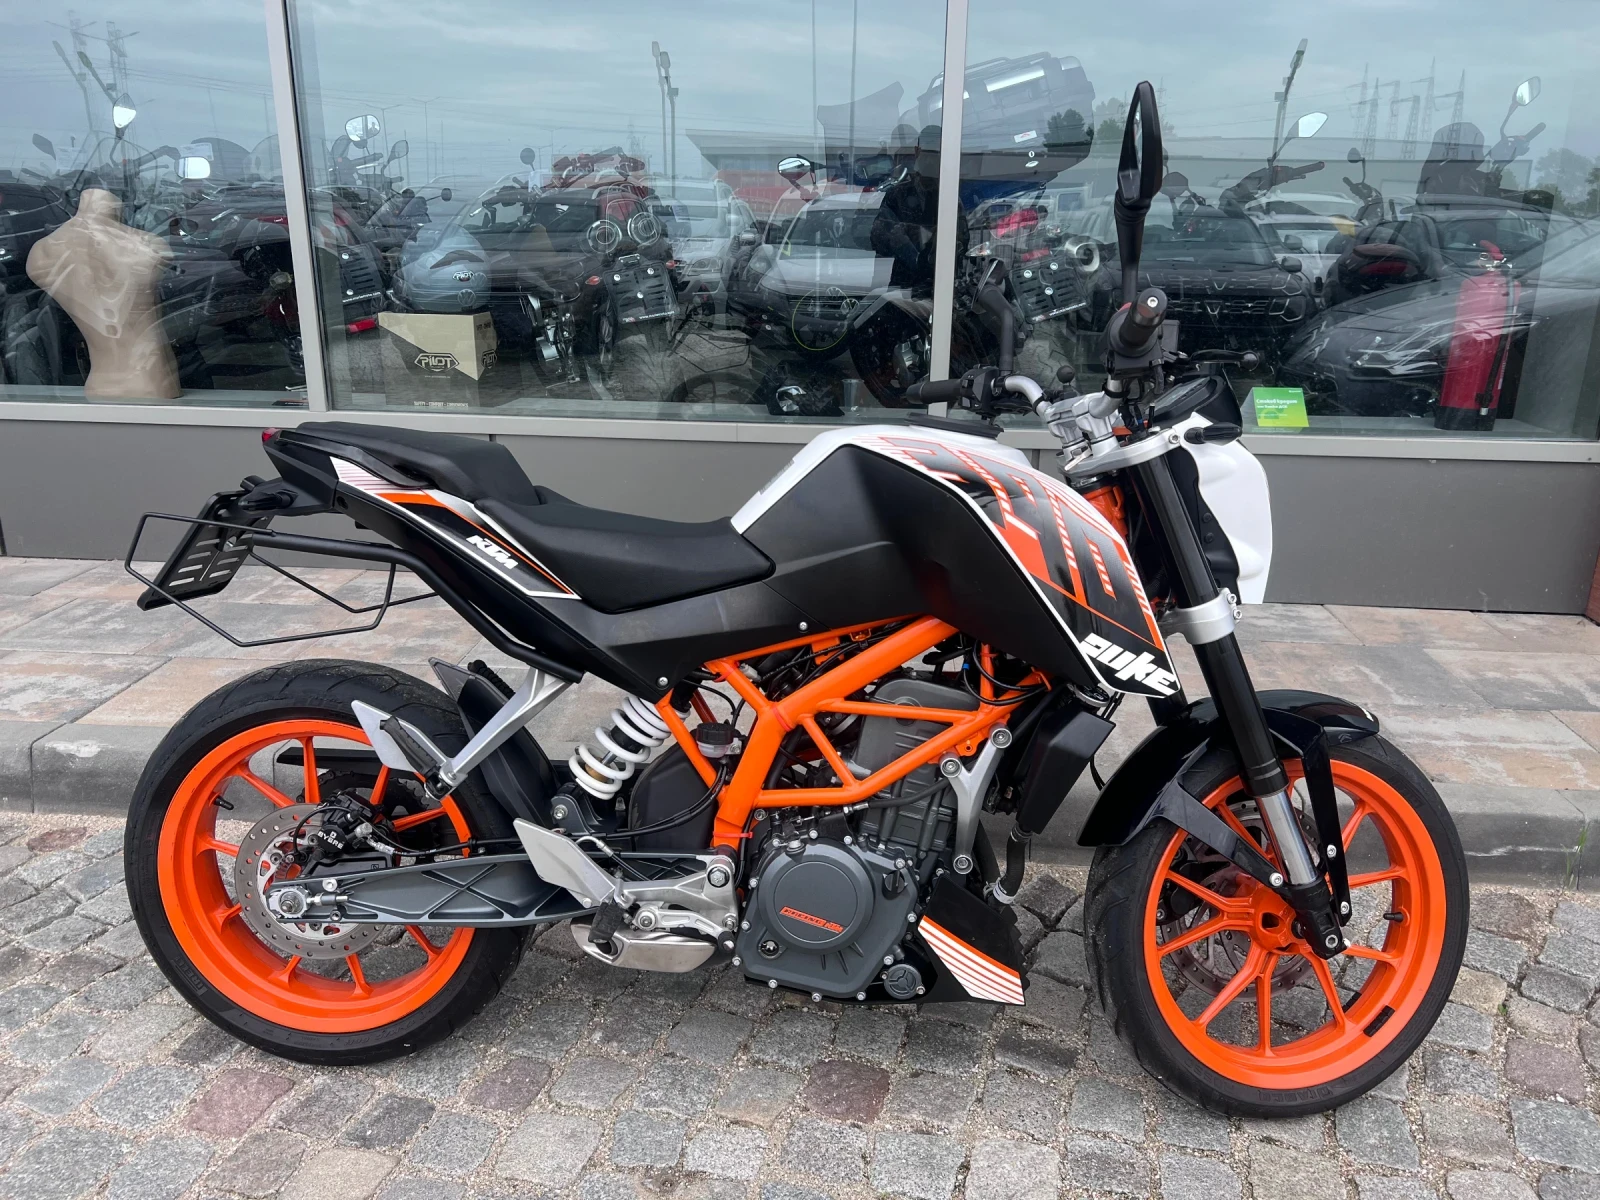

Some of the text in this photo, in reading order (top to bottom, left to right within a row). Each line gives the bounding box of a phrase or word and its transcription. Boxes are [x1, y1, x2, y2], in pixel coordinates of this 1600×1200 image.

[466, 535, 518, 570] KTM
[1080, 632, 1176, 696] DUKE
[780, 906, 827, 927] RACING
